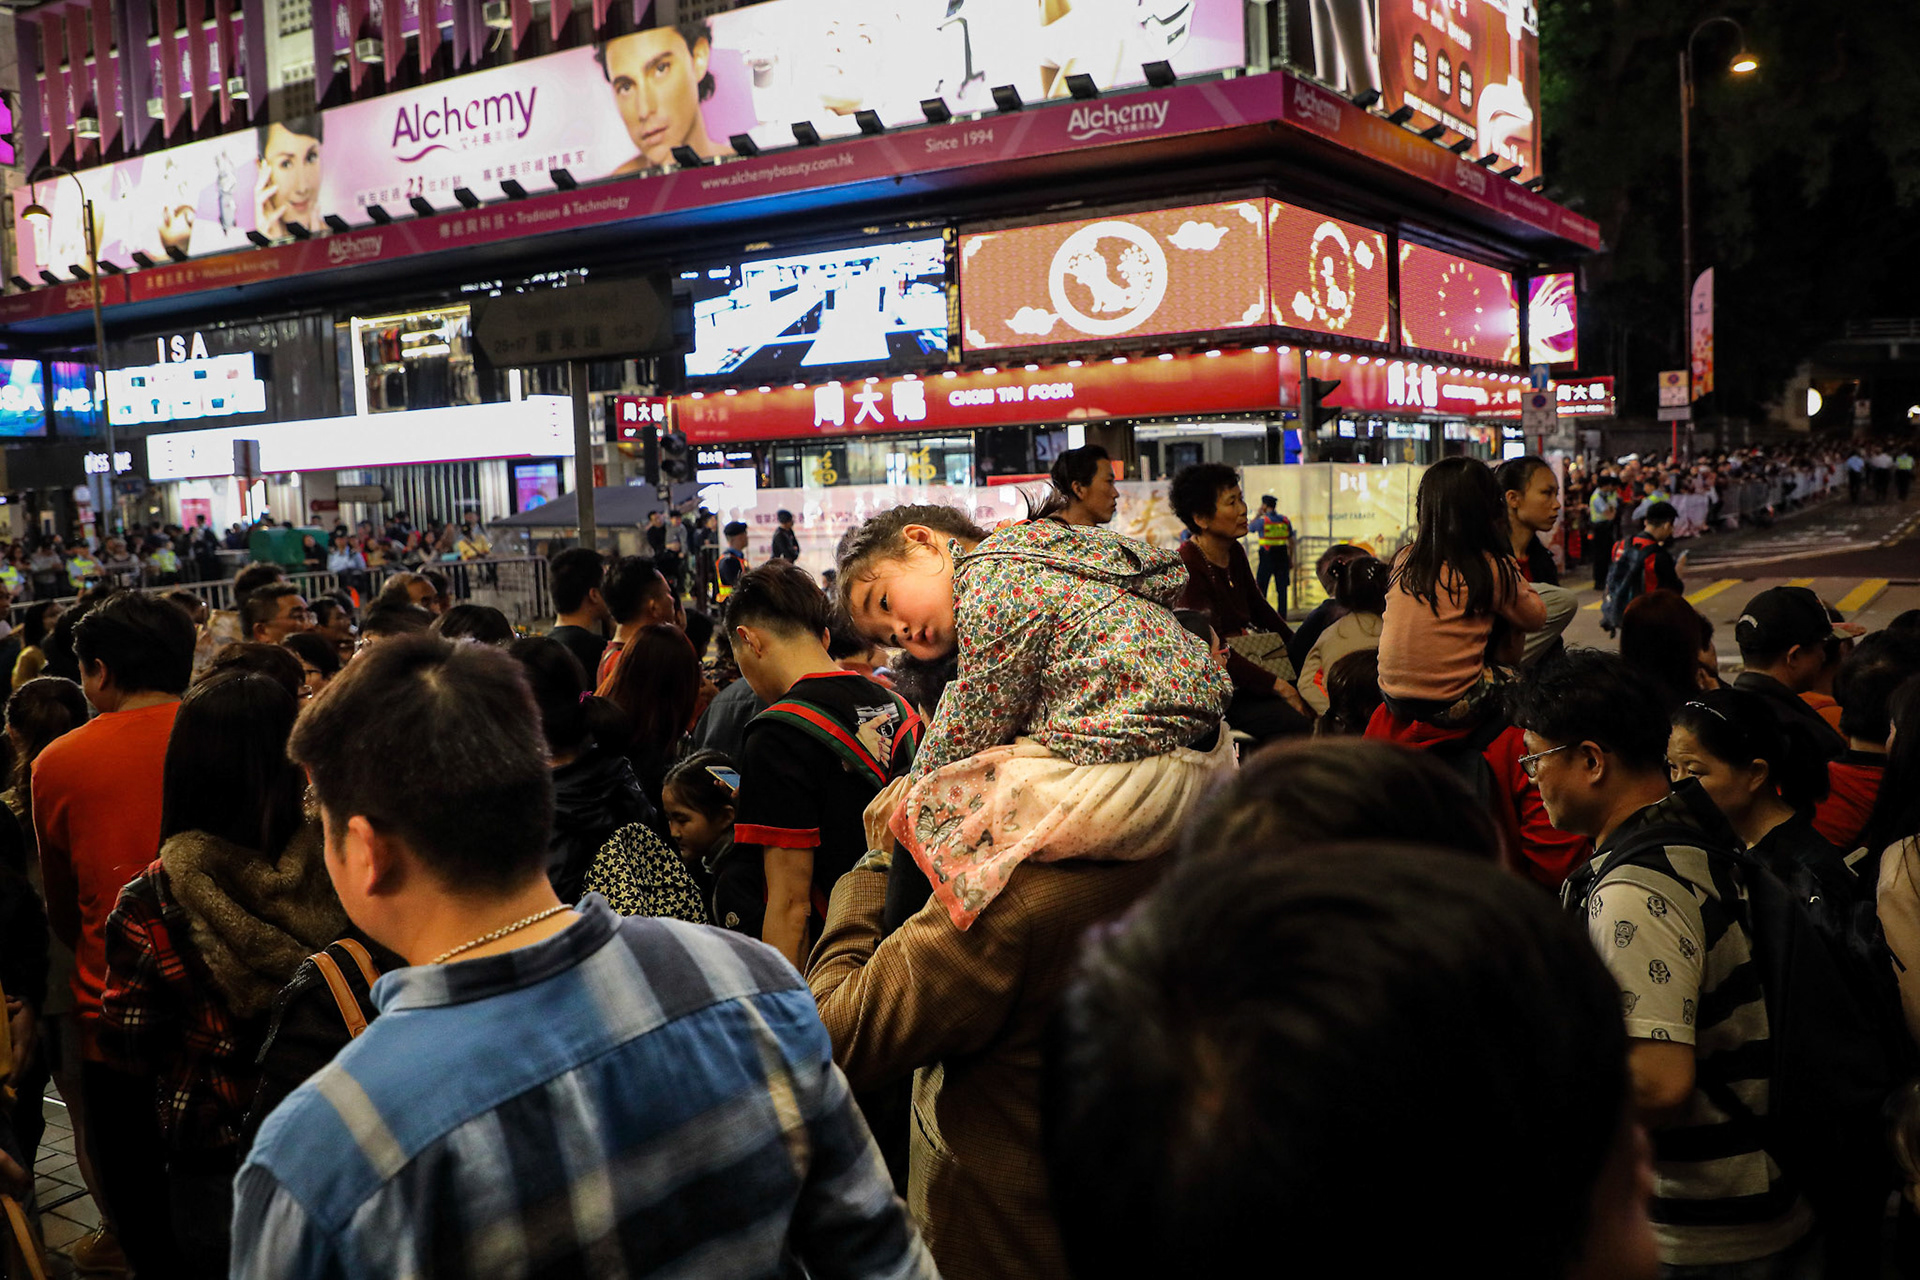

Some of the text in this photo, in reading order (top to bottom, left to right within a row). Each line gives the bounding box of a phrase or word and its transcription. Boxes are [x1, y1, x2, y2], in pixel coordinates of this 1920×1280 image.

[392, 86, 537, 147] Alchemy
[1067, 100, 1170, 132] Alchemy
[925, 129, 994, 153] Since 1994
[701, 153, 854, 190] www.alchemybeauty.com.hk
[516, 208, 560, 226] Tradition
[562, 205, 571, 217] &
[572, 194, 630, 216] Technology
[157, 332, 209, 364] ISA
[623, 402, 665, 422] 周大福
[813, 380, 1075, 427] 周大福 CHOW TAI FOOK
